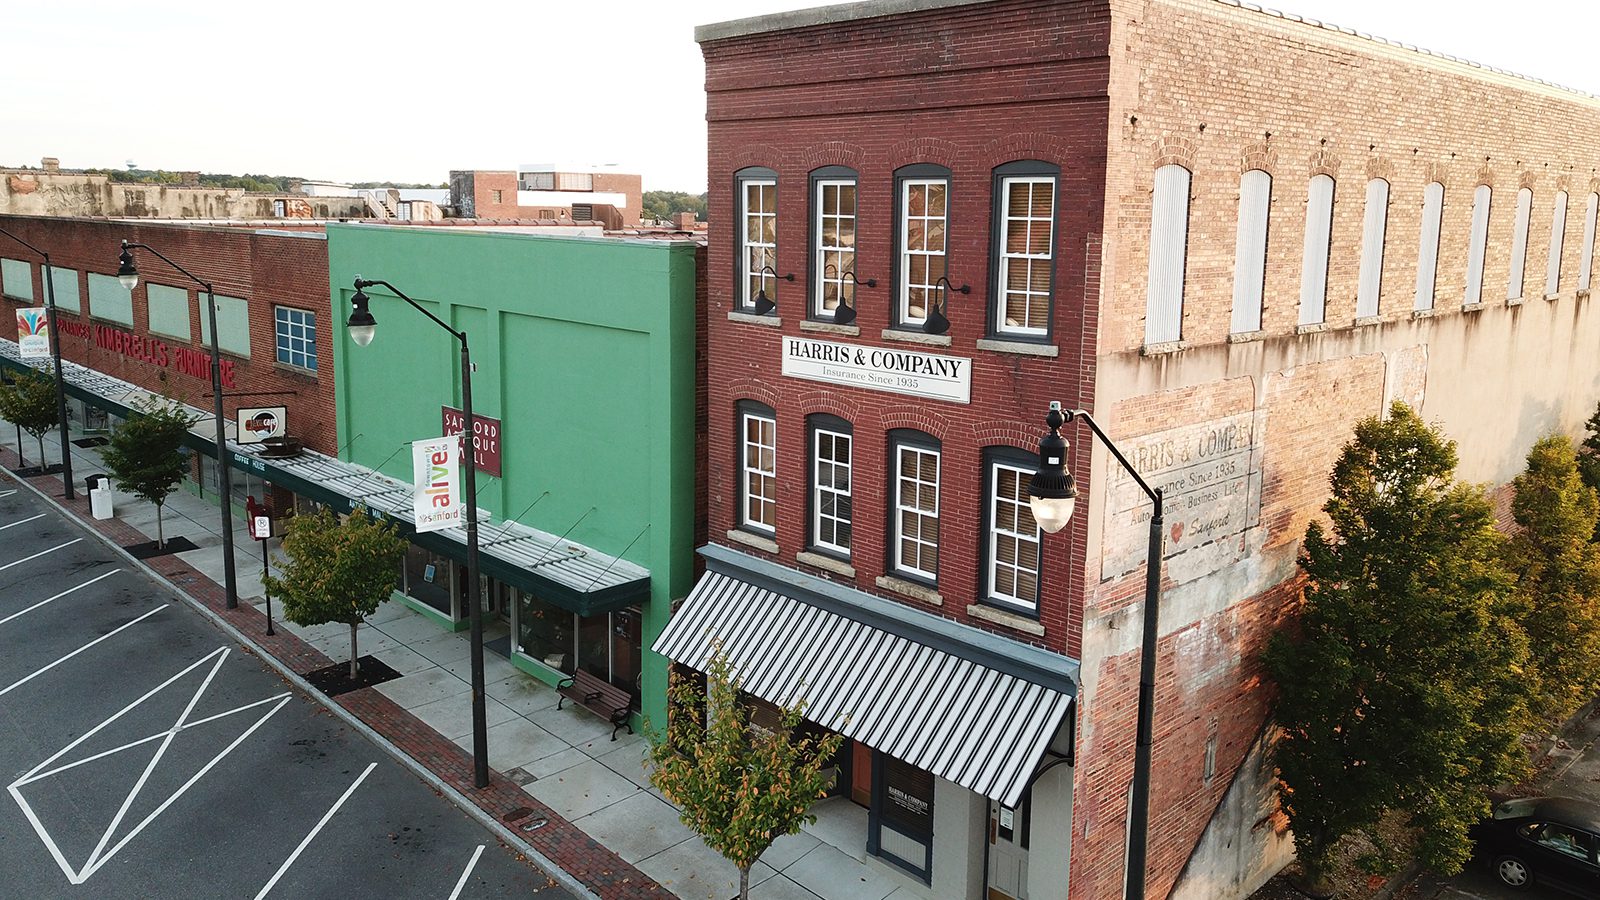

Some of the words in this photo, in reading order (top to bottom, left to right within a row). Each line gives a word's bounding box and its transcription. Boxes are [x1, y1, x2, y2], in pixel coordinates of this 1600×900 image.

[174, 346, 236, 389] FURNITRE
[788, 340, 850, 364] HARRIS
[854, 348, 866, 366] &
[871, 350, 962, 378] COMPANY
[822, 366, 866, 382] Insurance
[868, 373, 893, 386] Since
[896, 377, 919, 389] 1935
[446, 413, 497, 437] SANORD
[447, 428, 496, 454] AIQUE
[1198, 424, 1258, 457] COMPA
[234, 453, 249, 465] COFFEE
[252, 460, 266, 472] HOUSE
[425, 451, 450, 508] alive
[1138, 479, 1186, 502] Inance
[1189, 471, 1213, 487] Since
[1215, 461, 1236, 479] 1935
[428, 509, 459, 523] sanford
